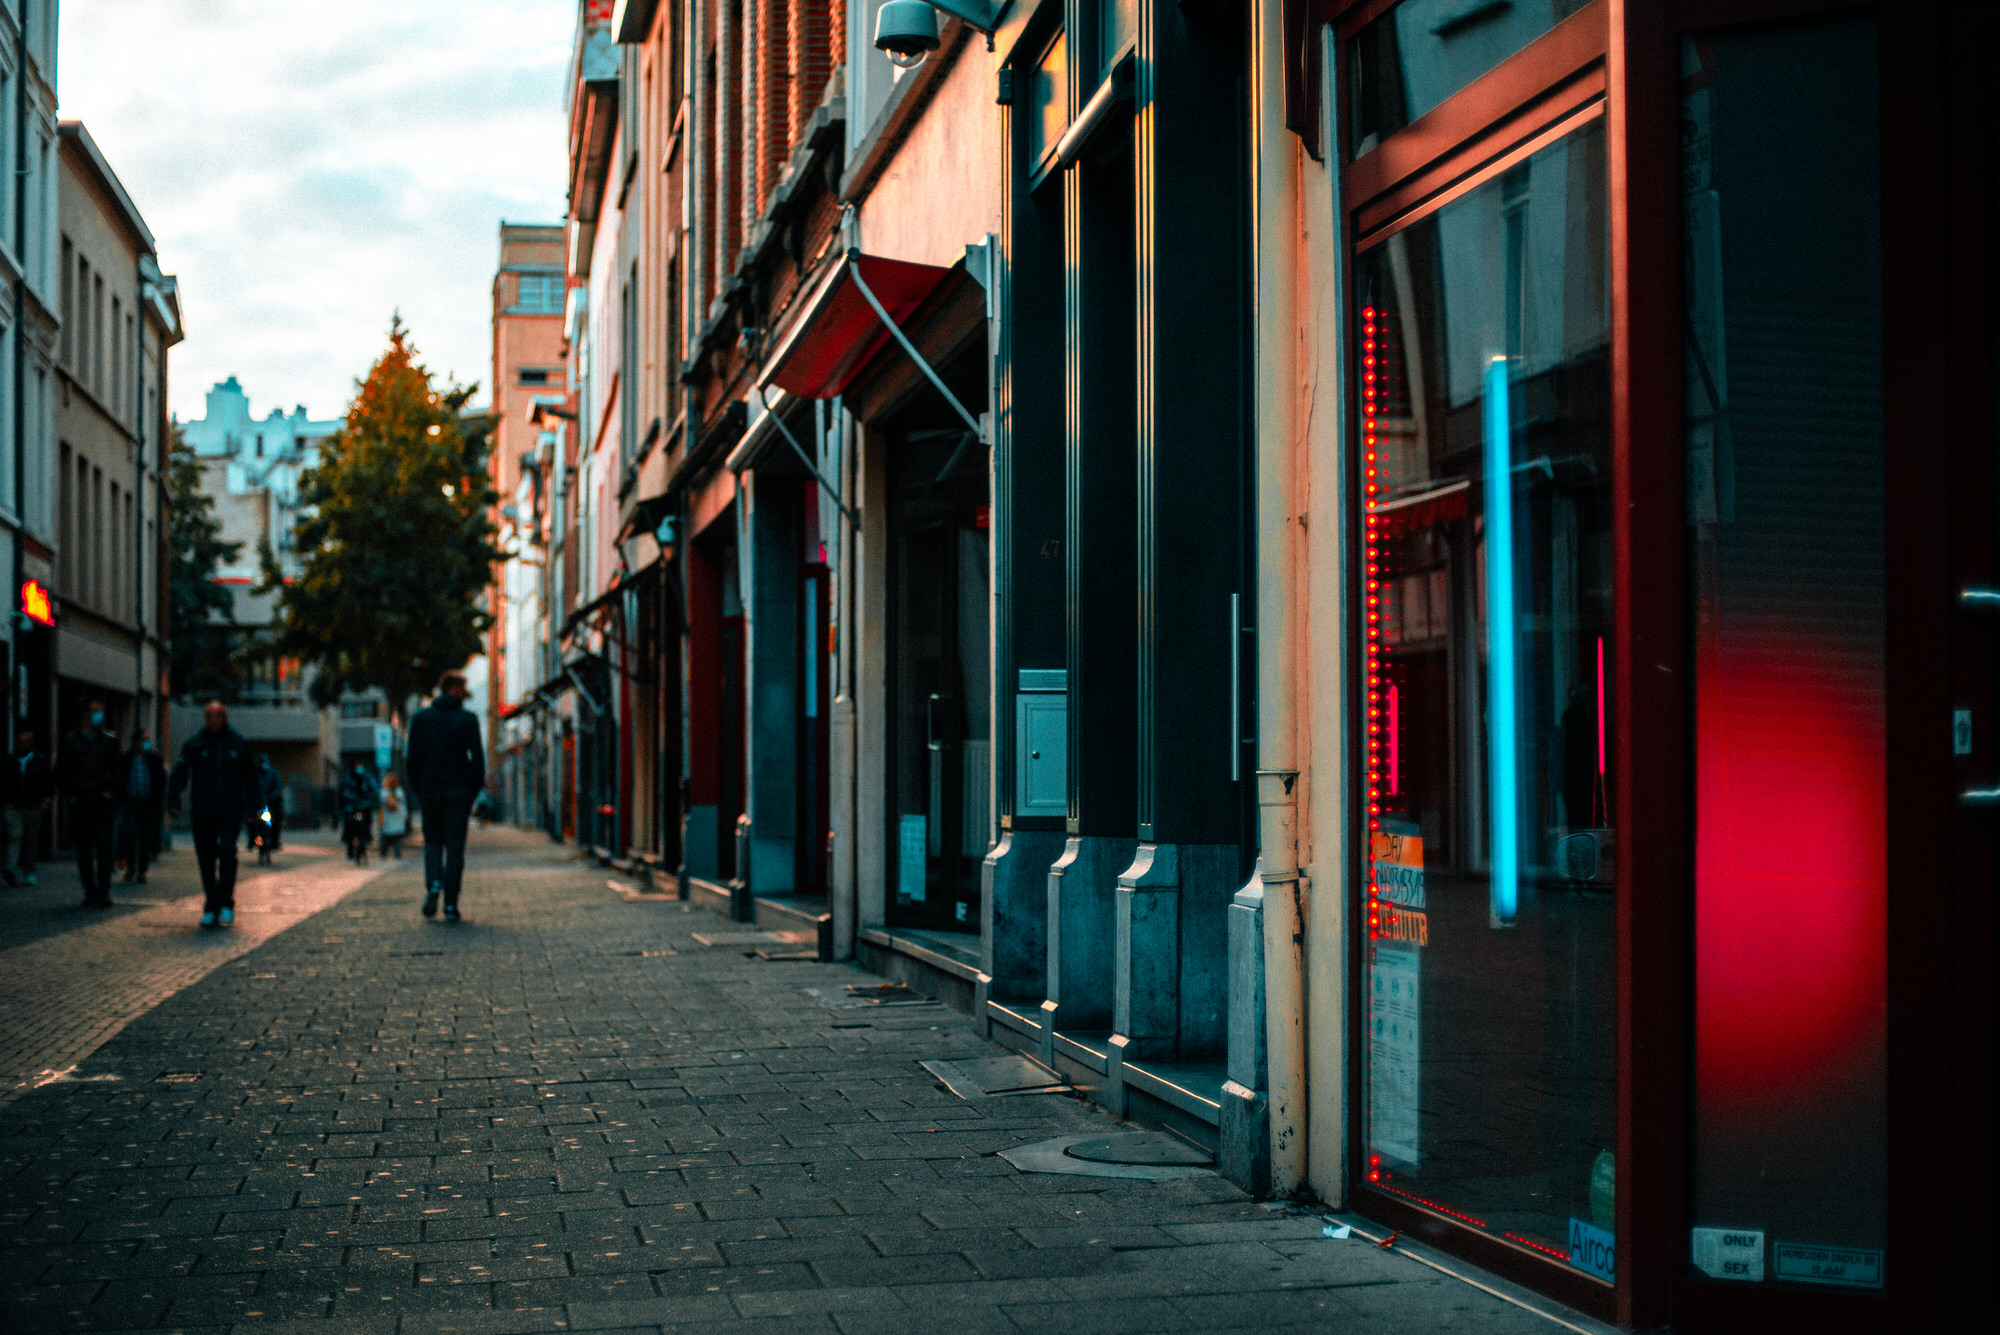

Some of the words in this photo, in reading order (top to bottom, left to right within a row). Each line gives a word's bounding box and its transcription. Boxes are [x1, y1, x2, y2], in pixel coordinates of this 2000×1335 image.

[1723, 1234, 1757, 1247] ONLY
[1571, 1223, 1615, 1275] Airco
[1781, 1250, 1829, 1261] VERBODEN
[1831, 1254, 1863, 1265] ONDER
[1864, 1256, 1876, 1265] DE
[1724, 1262, 1750, 1275] SEX
[1822, 1265, 1846, 1275] JAAR
